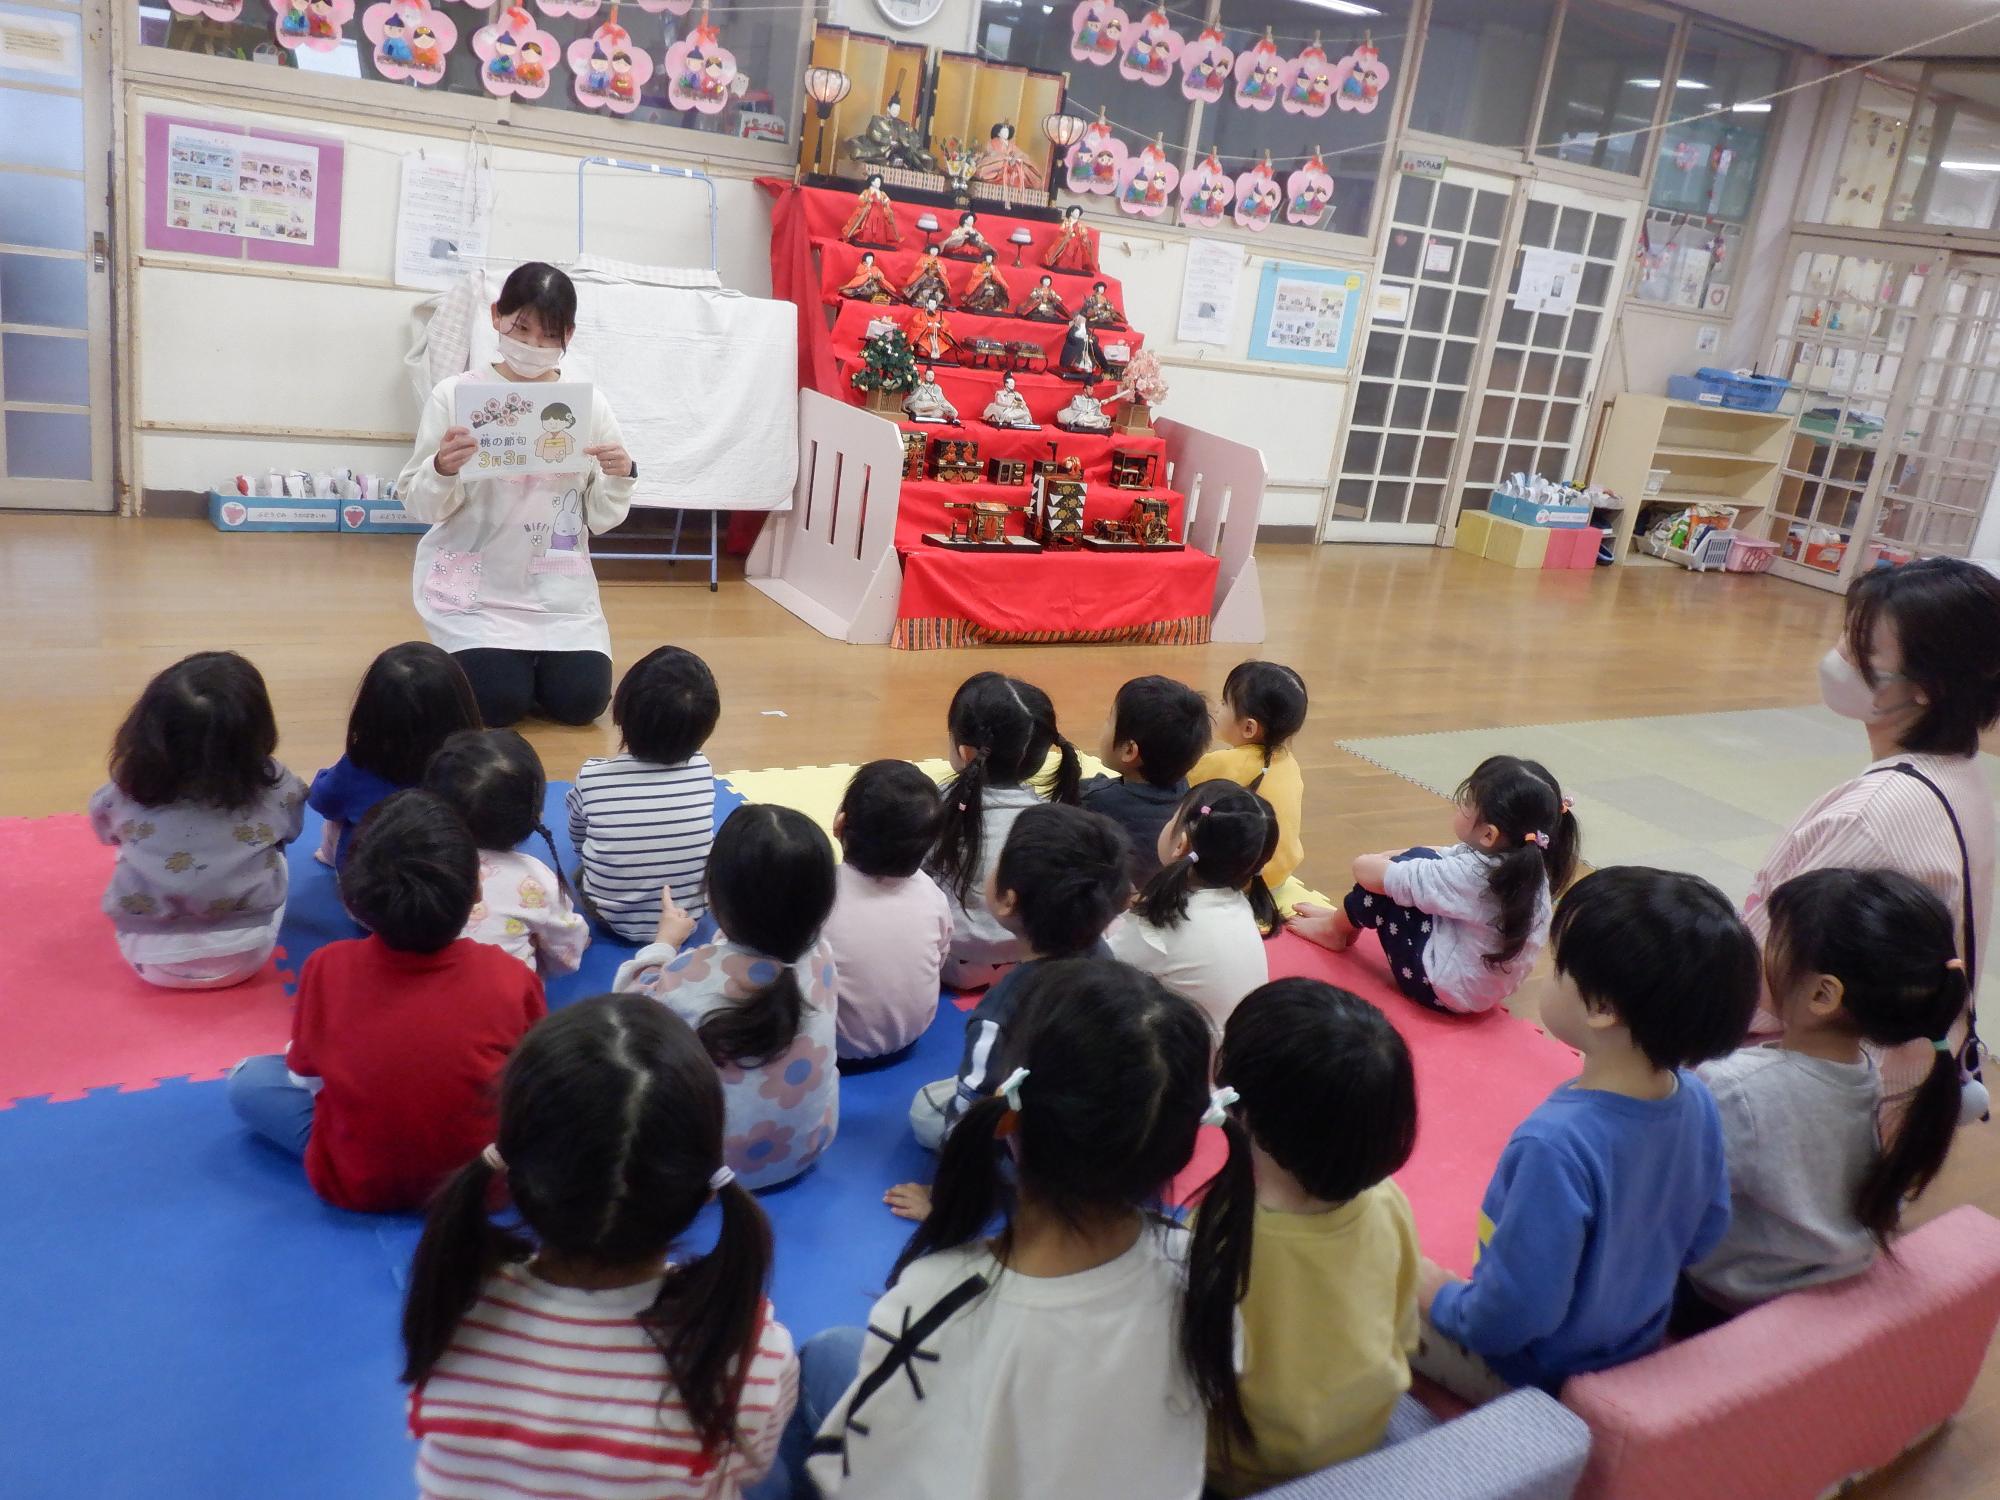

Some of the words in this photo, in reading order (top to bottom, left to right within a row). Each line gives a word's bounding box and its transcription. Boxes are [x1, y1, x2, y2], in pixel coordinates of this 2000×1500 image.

[480, 436, 527, 448] 桃の節句
[478, 449, 527, 468] 3月3日
